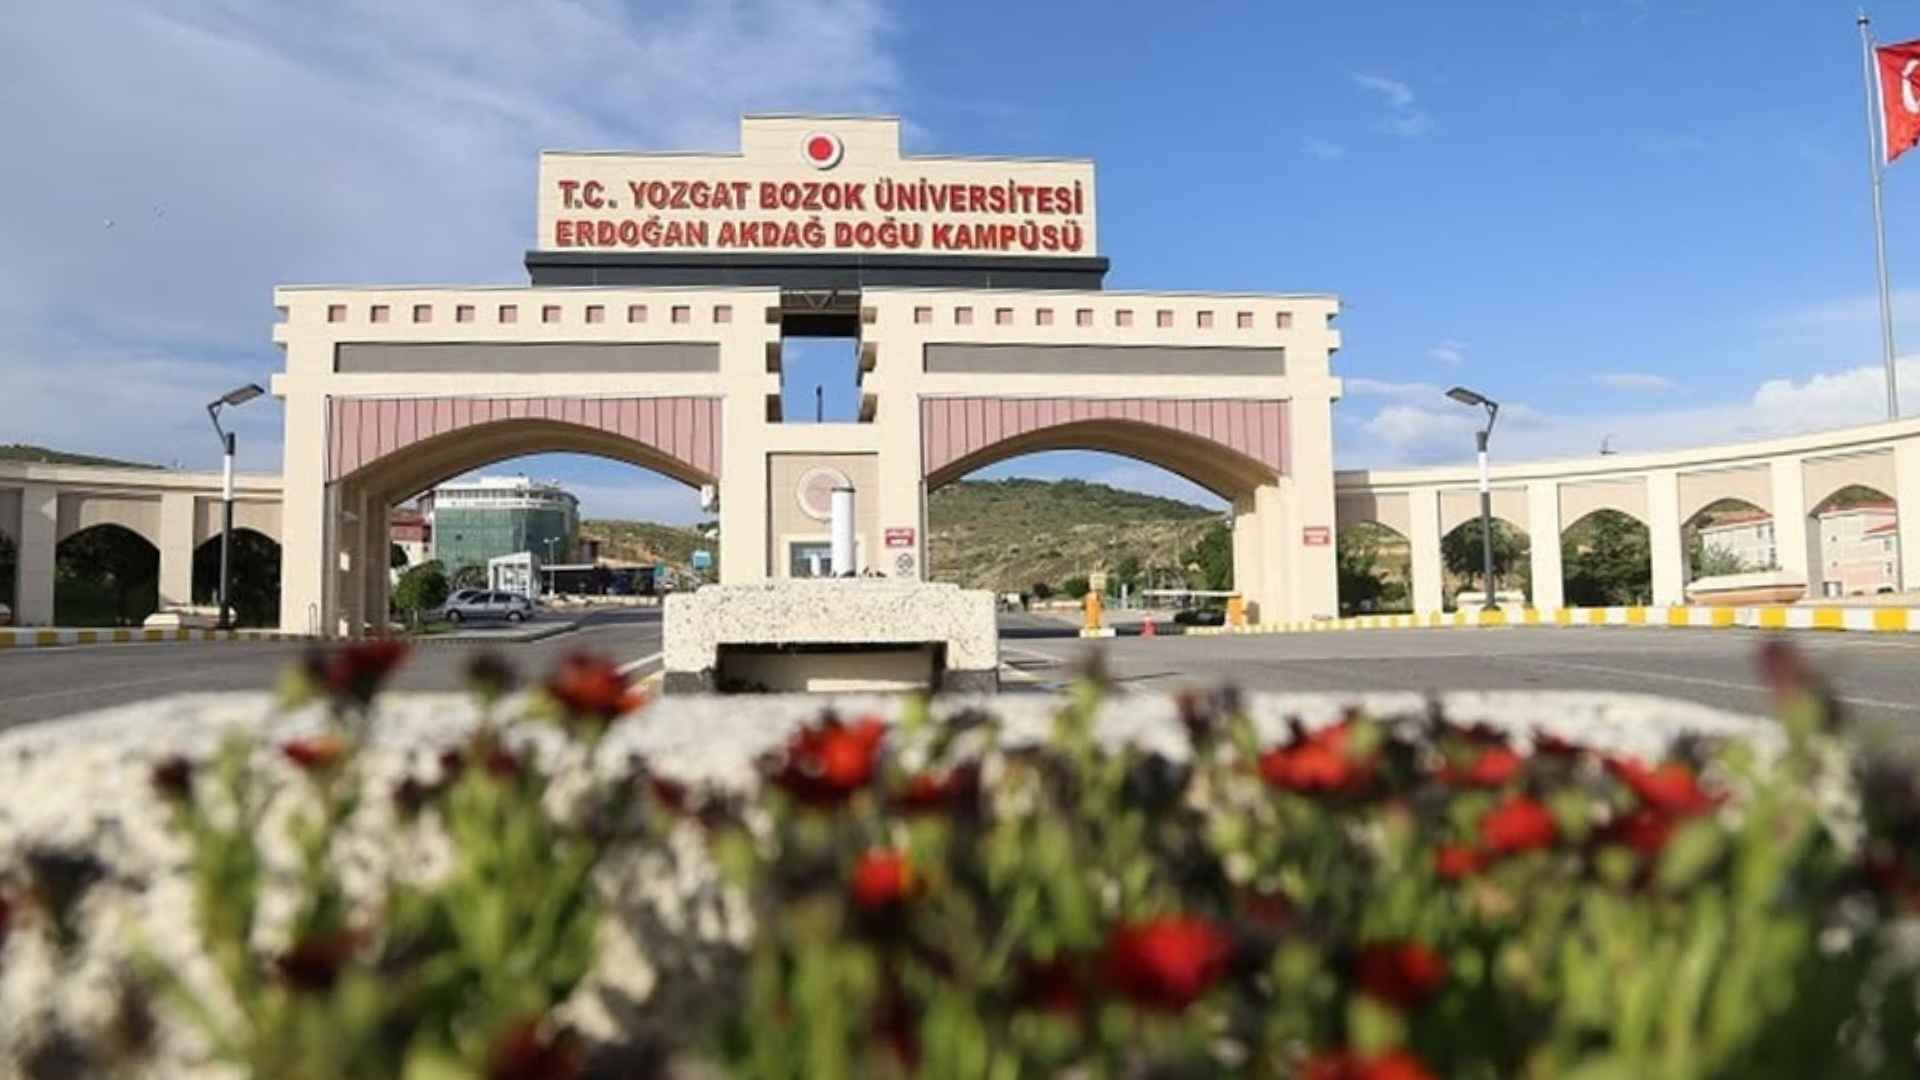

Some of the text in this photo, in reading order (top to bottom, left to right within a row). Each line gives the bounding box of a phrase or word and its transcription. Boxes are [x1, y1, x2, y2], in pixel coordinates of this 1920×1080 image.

[558, 176, 1083, 215] T.C. YOZGAT BOZOK ÜNİVERSİTESİ
[556, 214, 1083, 251] ERDOĞAN AKDAĞ DOĞU KAMPÜSÜ
